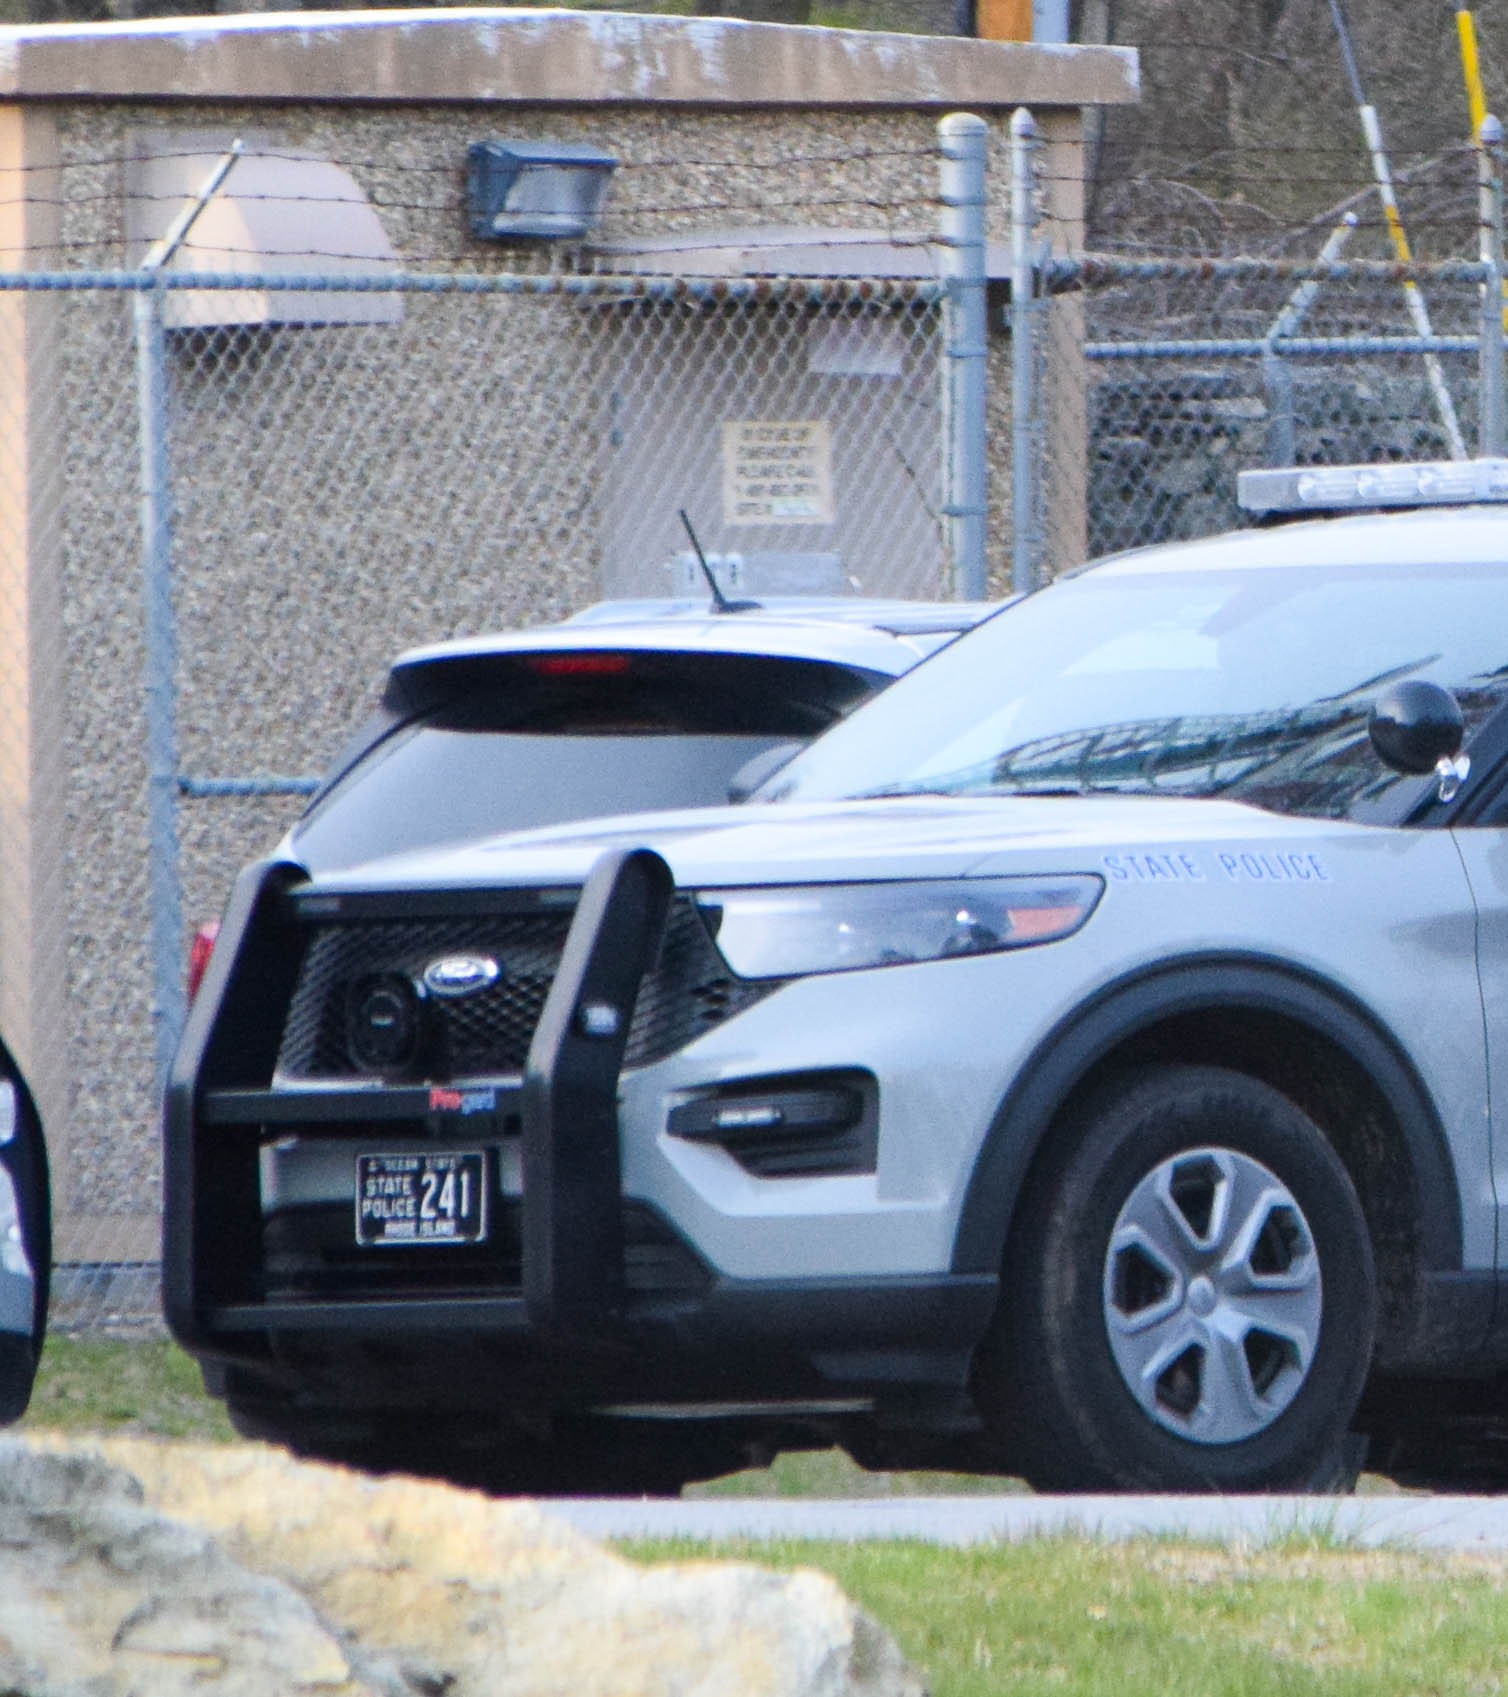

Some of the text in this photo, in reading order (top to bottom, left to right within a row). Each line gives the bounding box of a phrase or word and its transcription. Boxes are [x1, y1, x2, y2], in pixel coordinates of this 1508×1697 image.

[1102, 853, 1329, 882] STATE POLICE
[366, 1175, 412, 1197] STATE
[420, 1170, 470, 1218] 241
[362, 1197, 416, 1219] POLICE
